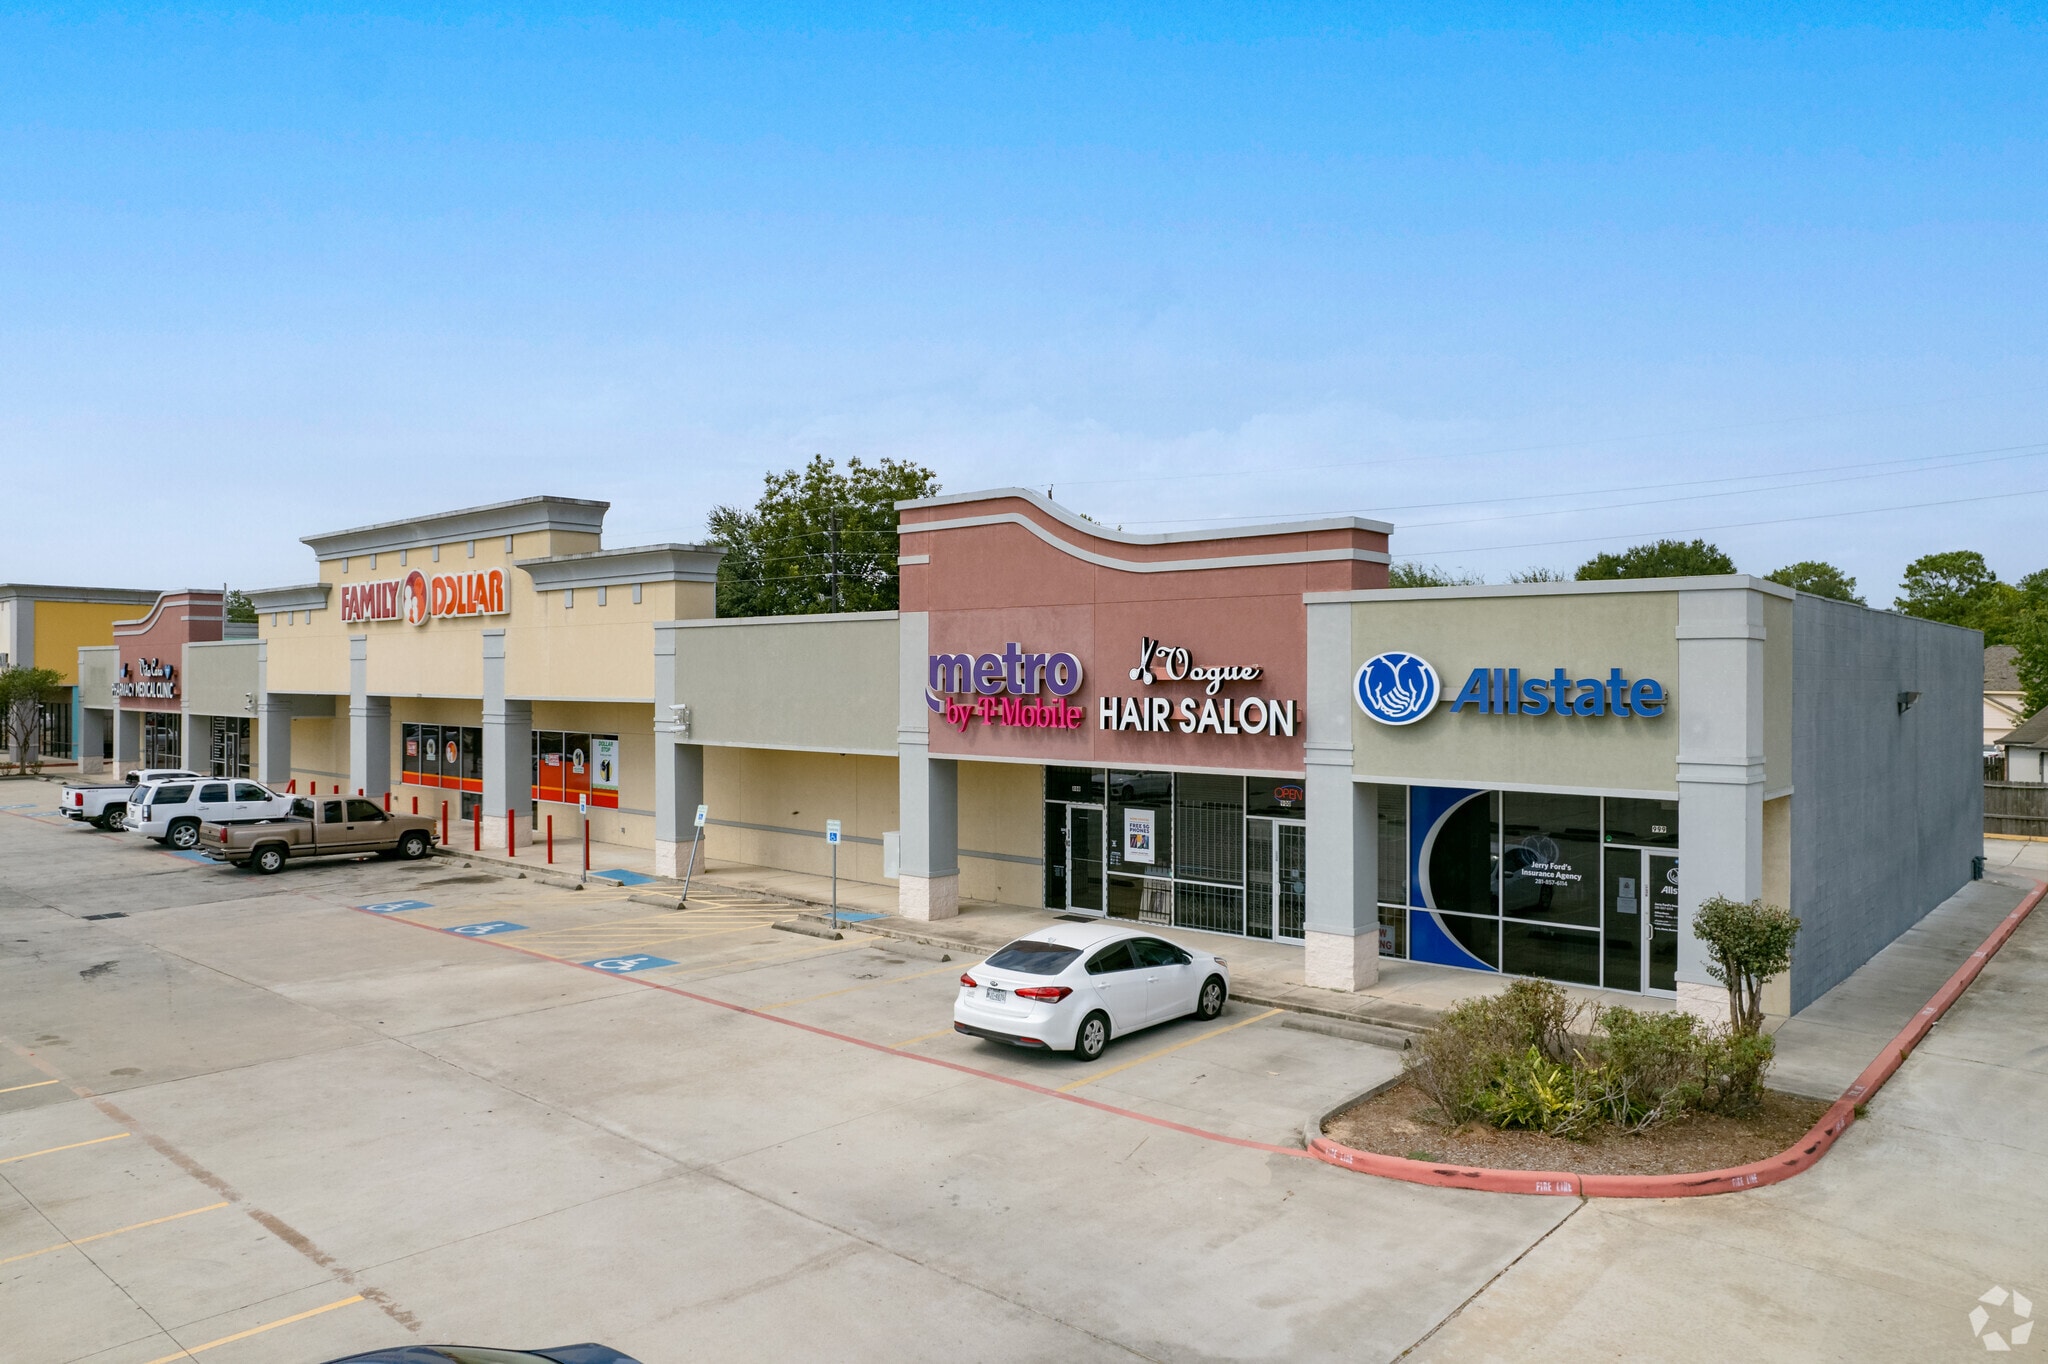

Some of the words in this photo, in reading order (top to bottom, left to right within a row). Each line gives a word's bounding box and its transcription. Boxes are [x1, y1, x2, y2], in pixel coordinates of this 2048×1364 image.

[341, 581, 401, 621] FAMILY
[431, 570, 504, 617] DOLLAR
[928, 642, 1083, 697] metro
[1155, 645, 1264, 696] Vogue
[1450, 668, 1666, 718] Allstate
[945, 696, 975, 733] by
[1100, 696, 1173, 733] HAIR
[1178, 696, 1298, 737] SALON
[1274, 786, 1303, 801] OPEN
[1652, 825, 1667, 833] 999
[1521, 868, 1555, 878] Insurance
[1555, 871, 1582, 882] Agency
[1531, 861, 1549, 870] Jerry
[1550, 862, 1572, 871] Ford's
